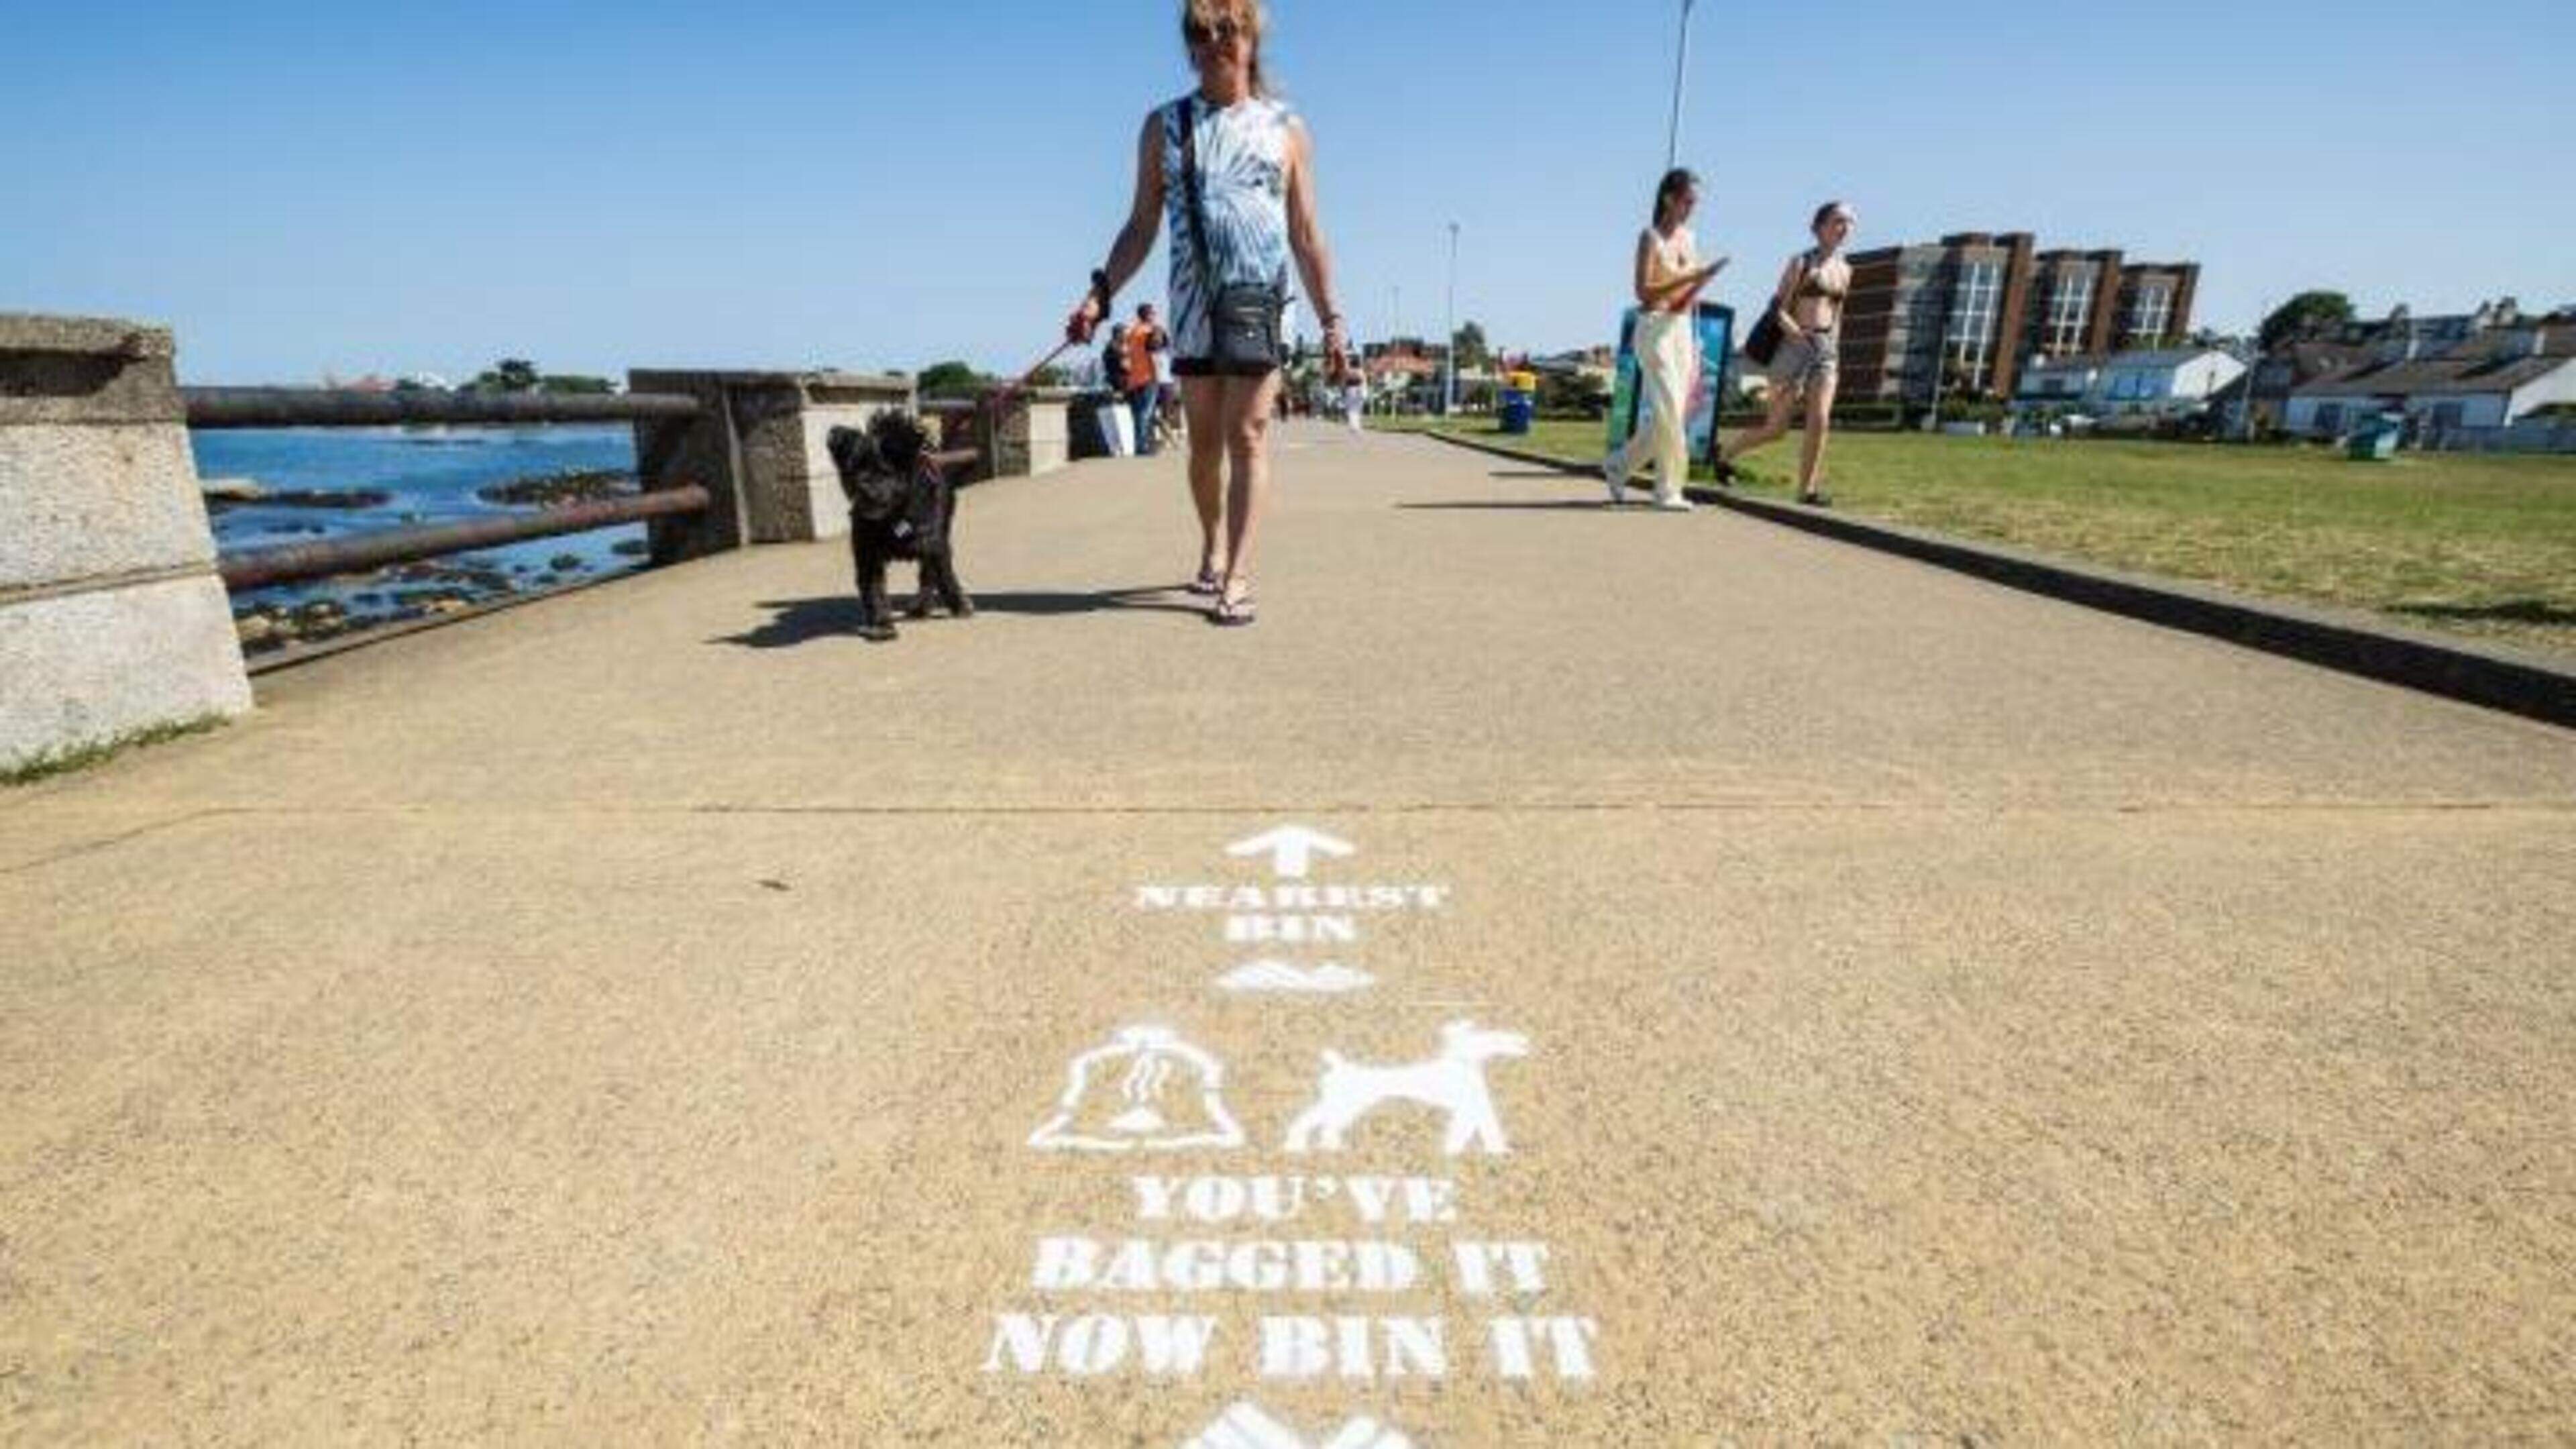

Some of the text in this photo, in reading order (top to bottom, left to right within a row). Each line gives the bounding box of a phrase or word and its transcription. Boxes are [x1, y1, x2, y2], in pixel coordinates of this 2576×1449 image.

[1133, 883, 1452, 908] NEAREST
[1224, 915, 1356, 941] BIN
[1130, 1175, 1458, 1222] YOU'VE
[1031, 1237, 1550, 1294] BAGGED IT
[981, 1313, 1598, 1379] NOW BIN IT
